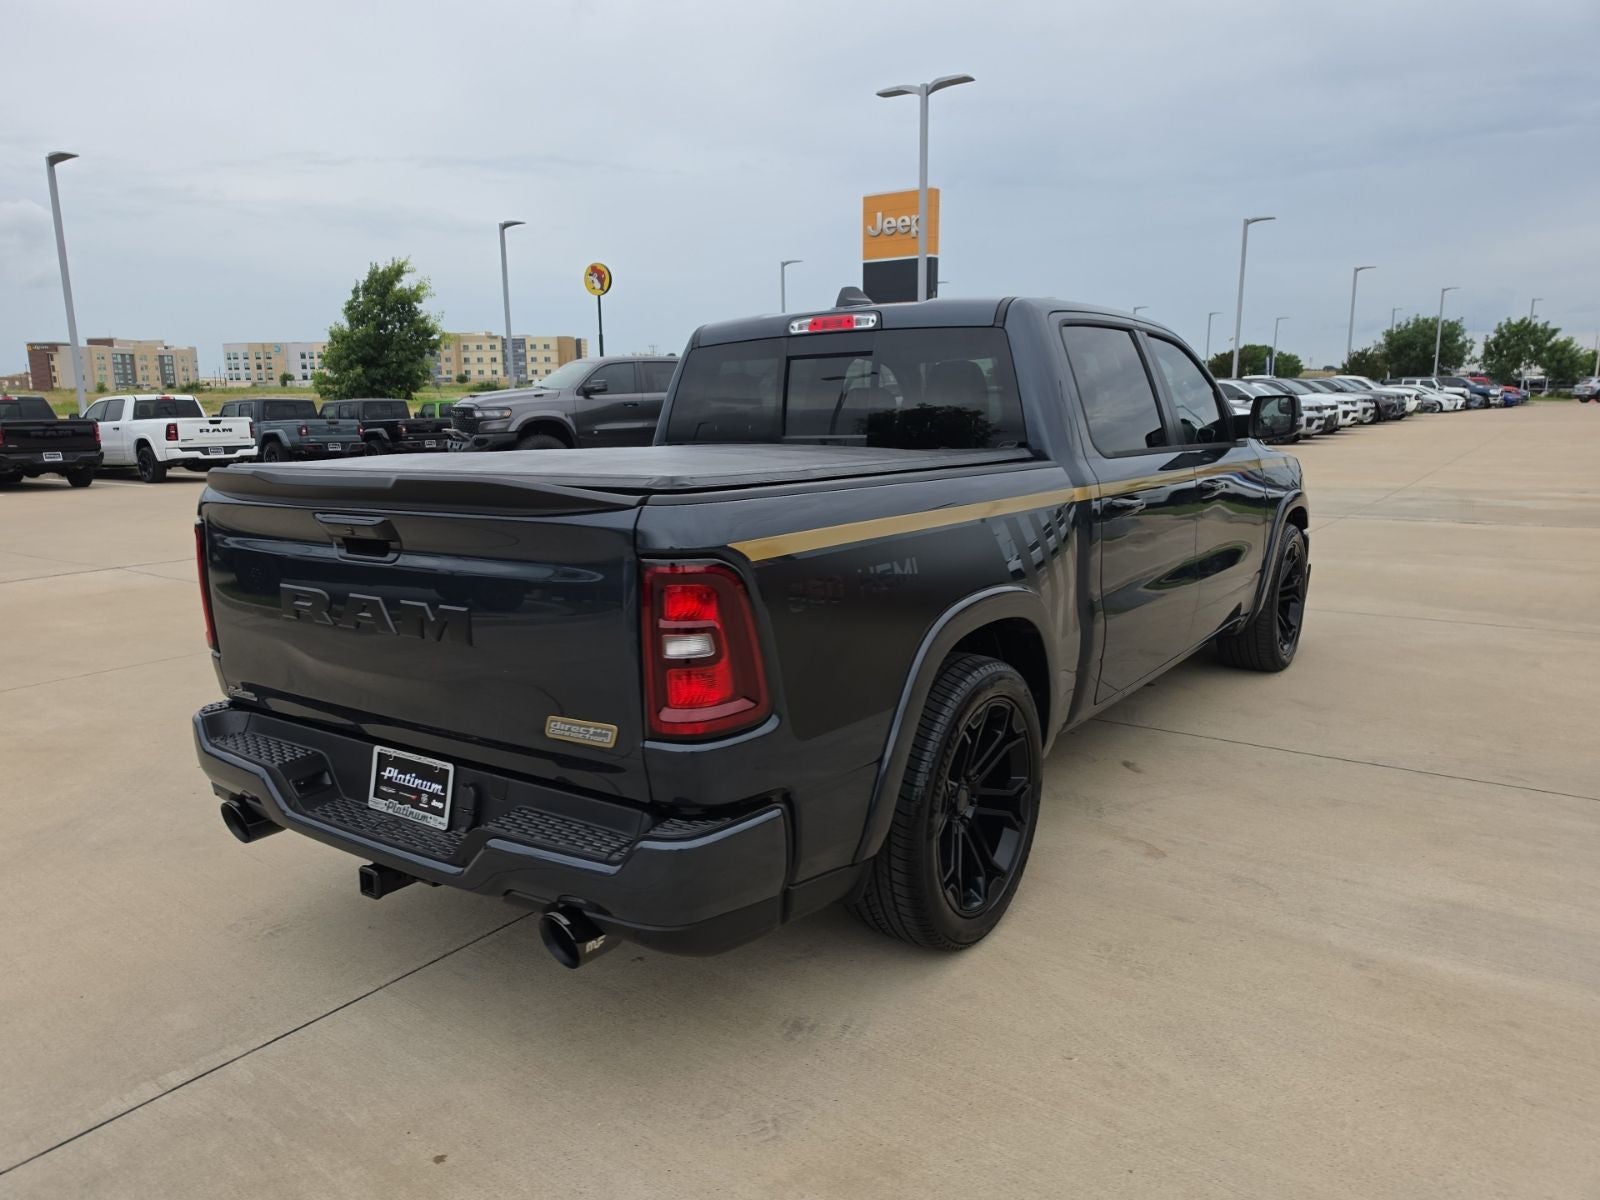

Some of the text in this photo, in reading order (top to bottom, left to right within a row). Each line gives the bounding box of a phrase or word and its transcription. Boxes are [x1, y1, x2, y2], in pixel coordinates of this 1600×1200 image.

[279, 582, 473, 647] RAM
[380, 766, 445, 796] Platinum
[386, 800, 430, 823] Platinum
